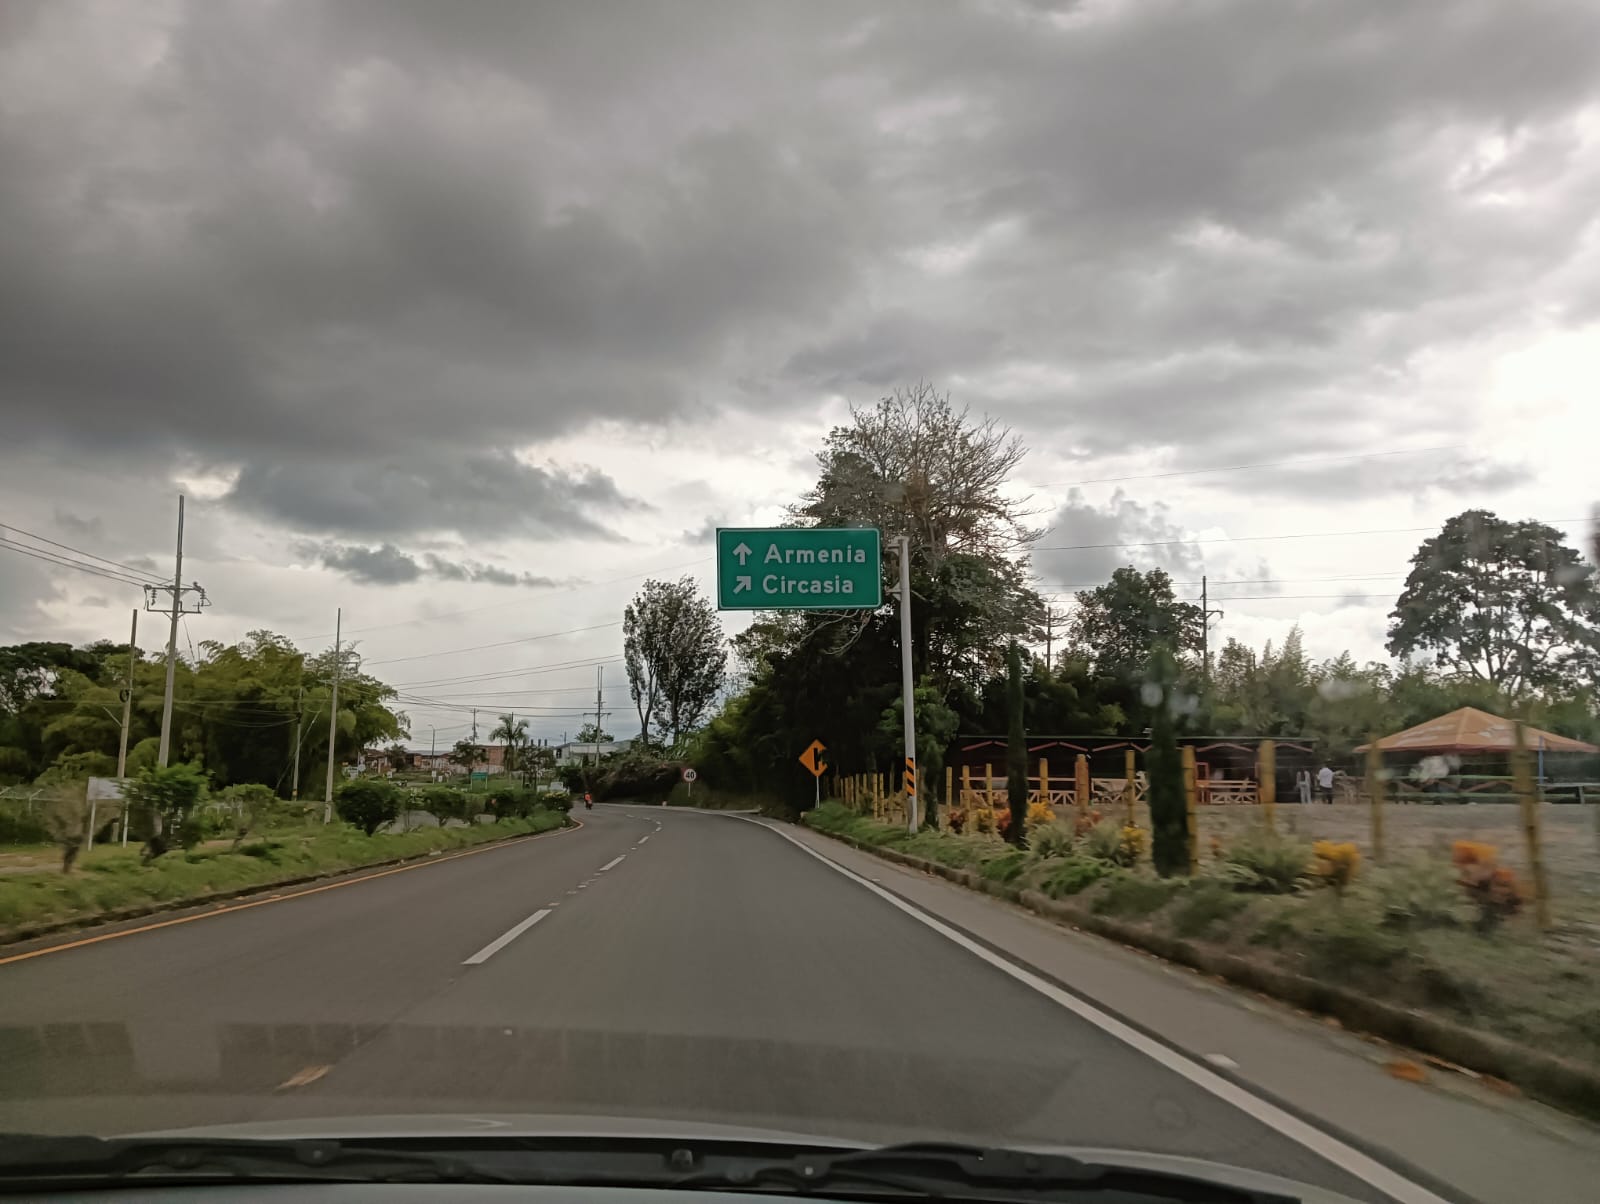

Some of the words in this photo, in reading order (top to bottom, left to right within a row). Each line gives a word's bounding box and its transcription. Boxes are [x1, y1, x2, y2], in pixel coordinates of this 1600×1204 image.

[764, 543, 866, 563] Armenia
[762, 574, 854, 594] Circasia
[685, 771, 695, 779] 40
